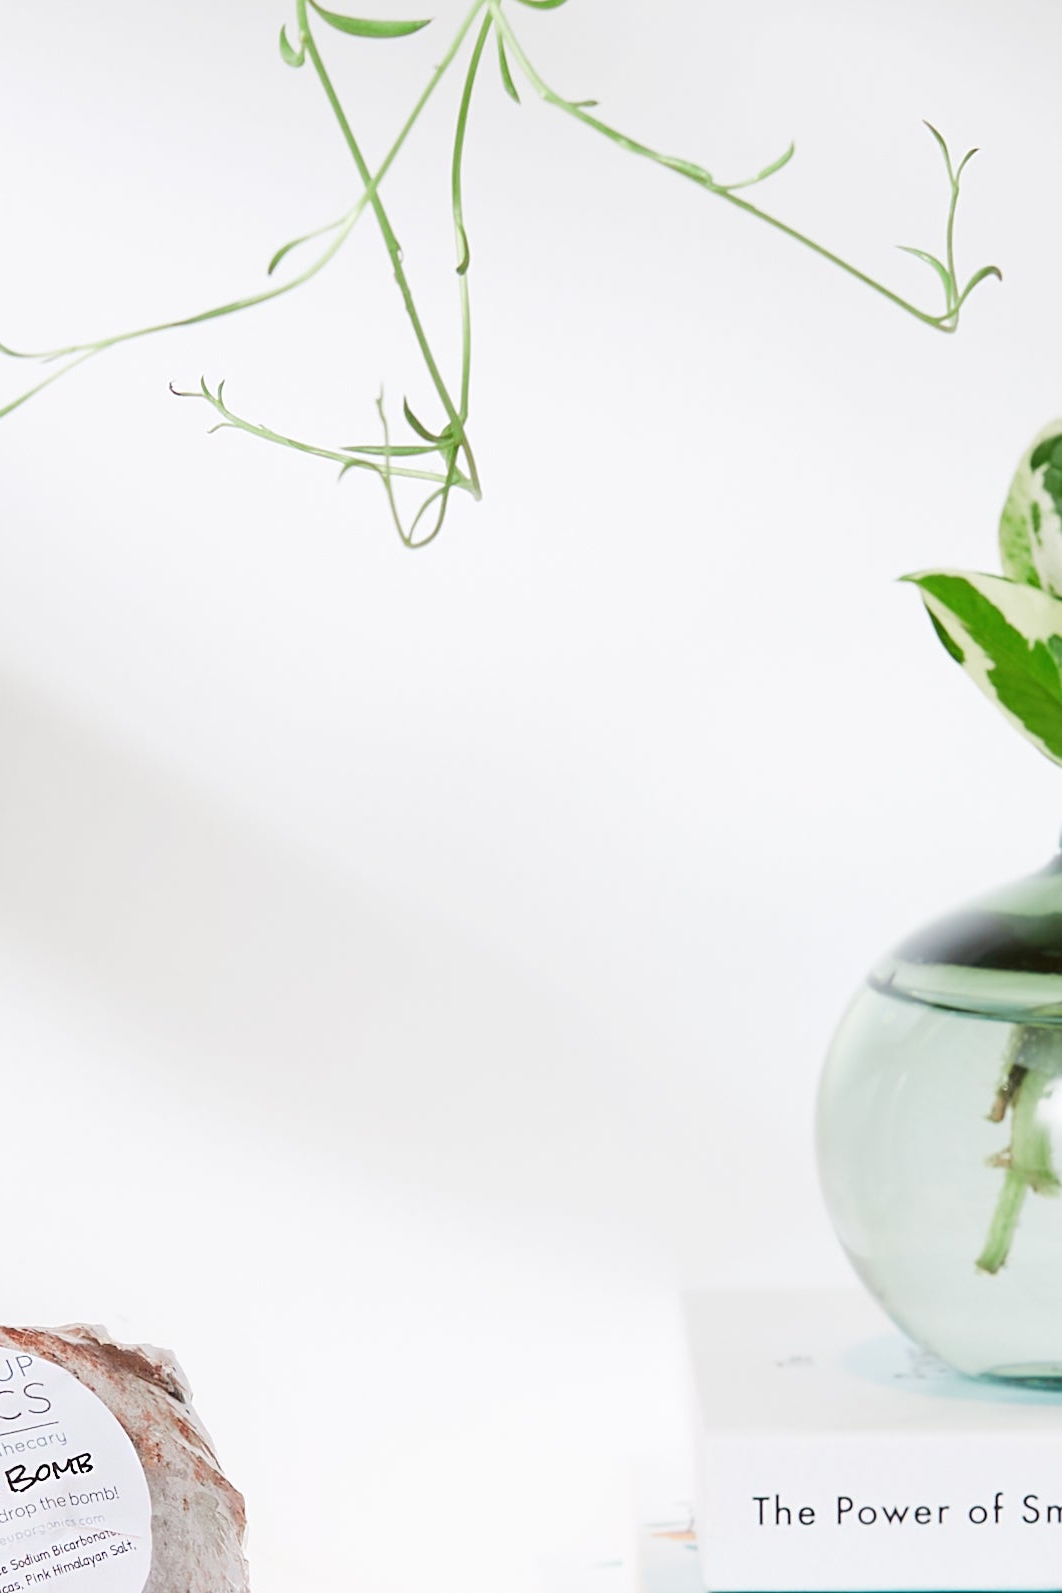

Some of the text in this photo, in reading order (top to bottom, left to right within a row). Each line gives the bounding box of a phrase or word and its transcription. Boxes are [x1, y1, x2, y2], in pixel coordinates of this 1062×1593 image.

[5, 1453, 93, 1492] BOMB
[40, 1495, 66, 1511] the
[68, 1486, 120, 1507] bomb!
[752, 1494, 816, 1526] The
[837, 1495, 950, 1526] Power
[968, 1492, 1004, 1525] of
[10, 1551, 51, 1571] Sodium
[25, 1568, 52, 1586] Pink
[53, 1550, 108, 1577] Himalayan
